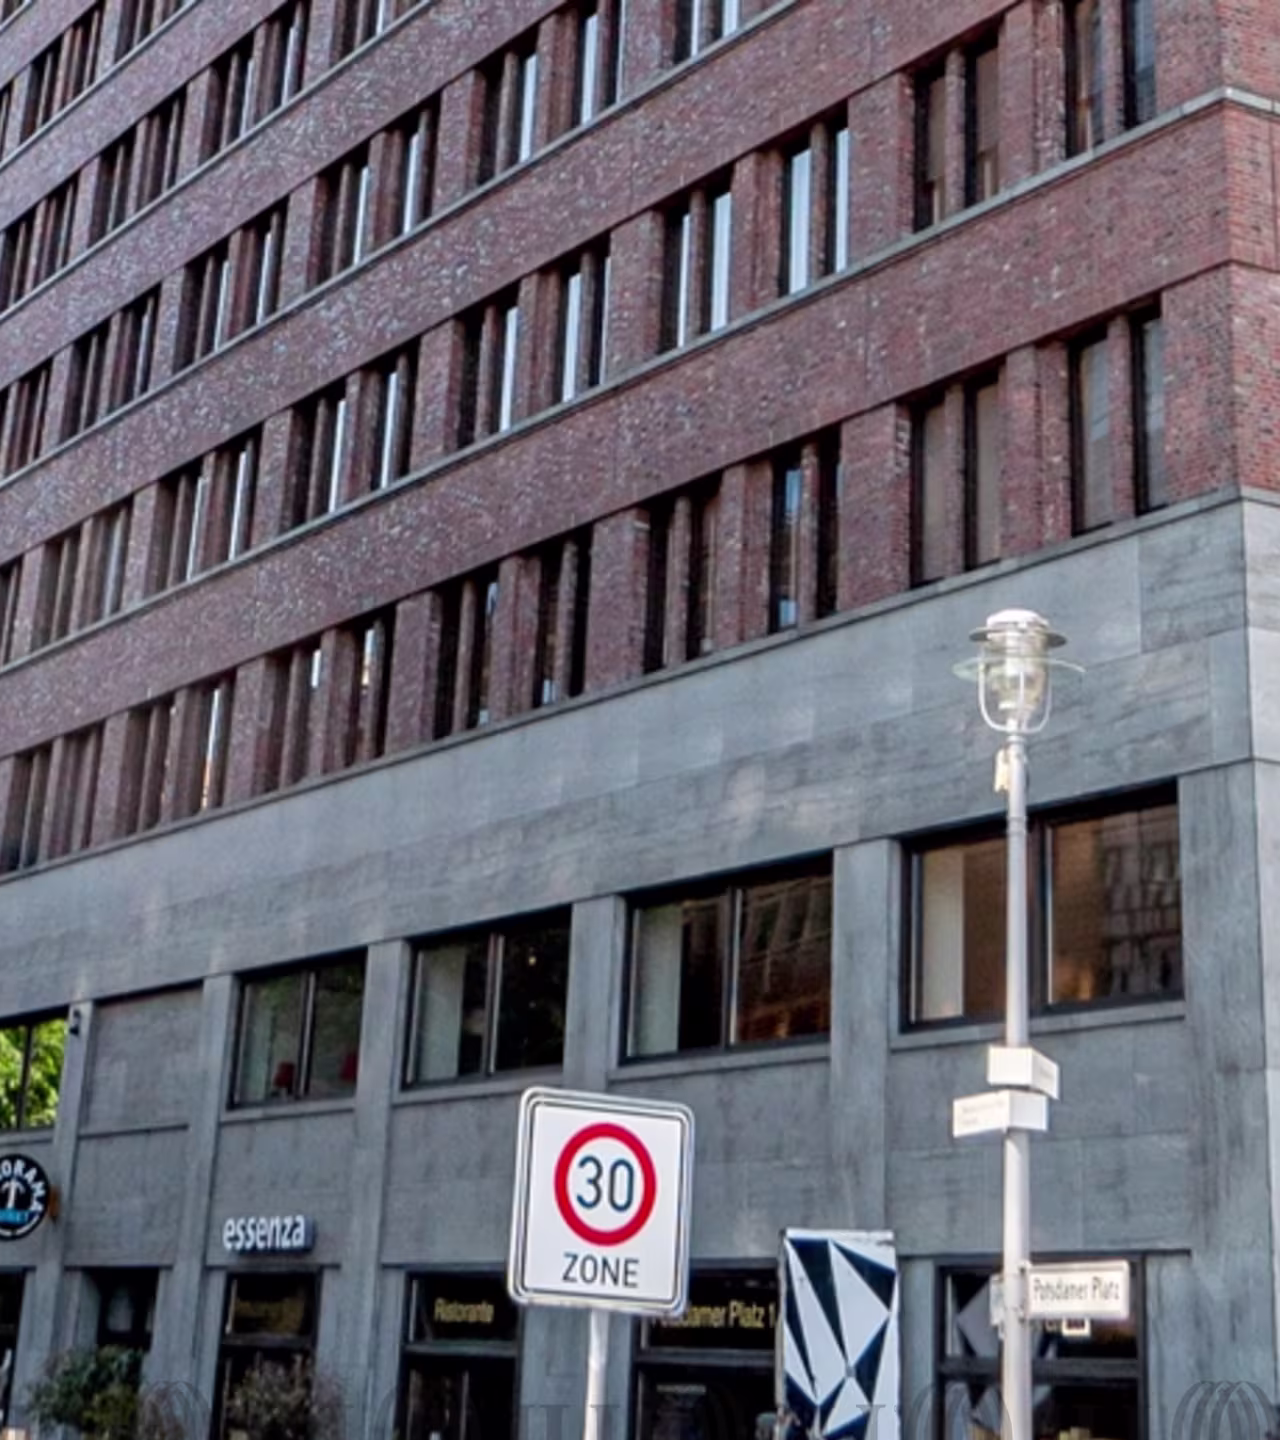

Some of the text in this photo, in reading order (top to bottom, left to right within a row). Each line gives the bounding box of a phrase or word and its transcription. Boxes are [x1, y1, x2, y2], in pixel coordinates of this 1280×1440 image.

[576, 1155, 634, 1212] 30
[222, 1214, 305, 1251] essenza
[562, 1251, 639, 1288] ZONE
[1033, 1275, 1121, 1301] Potsdamer Platz
[728, 1299, 765, 1328] Platz
